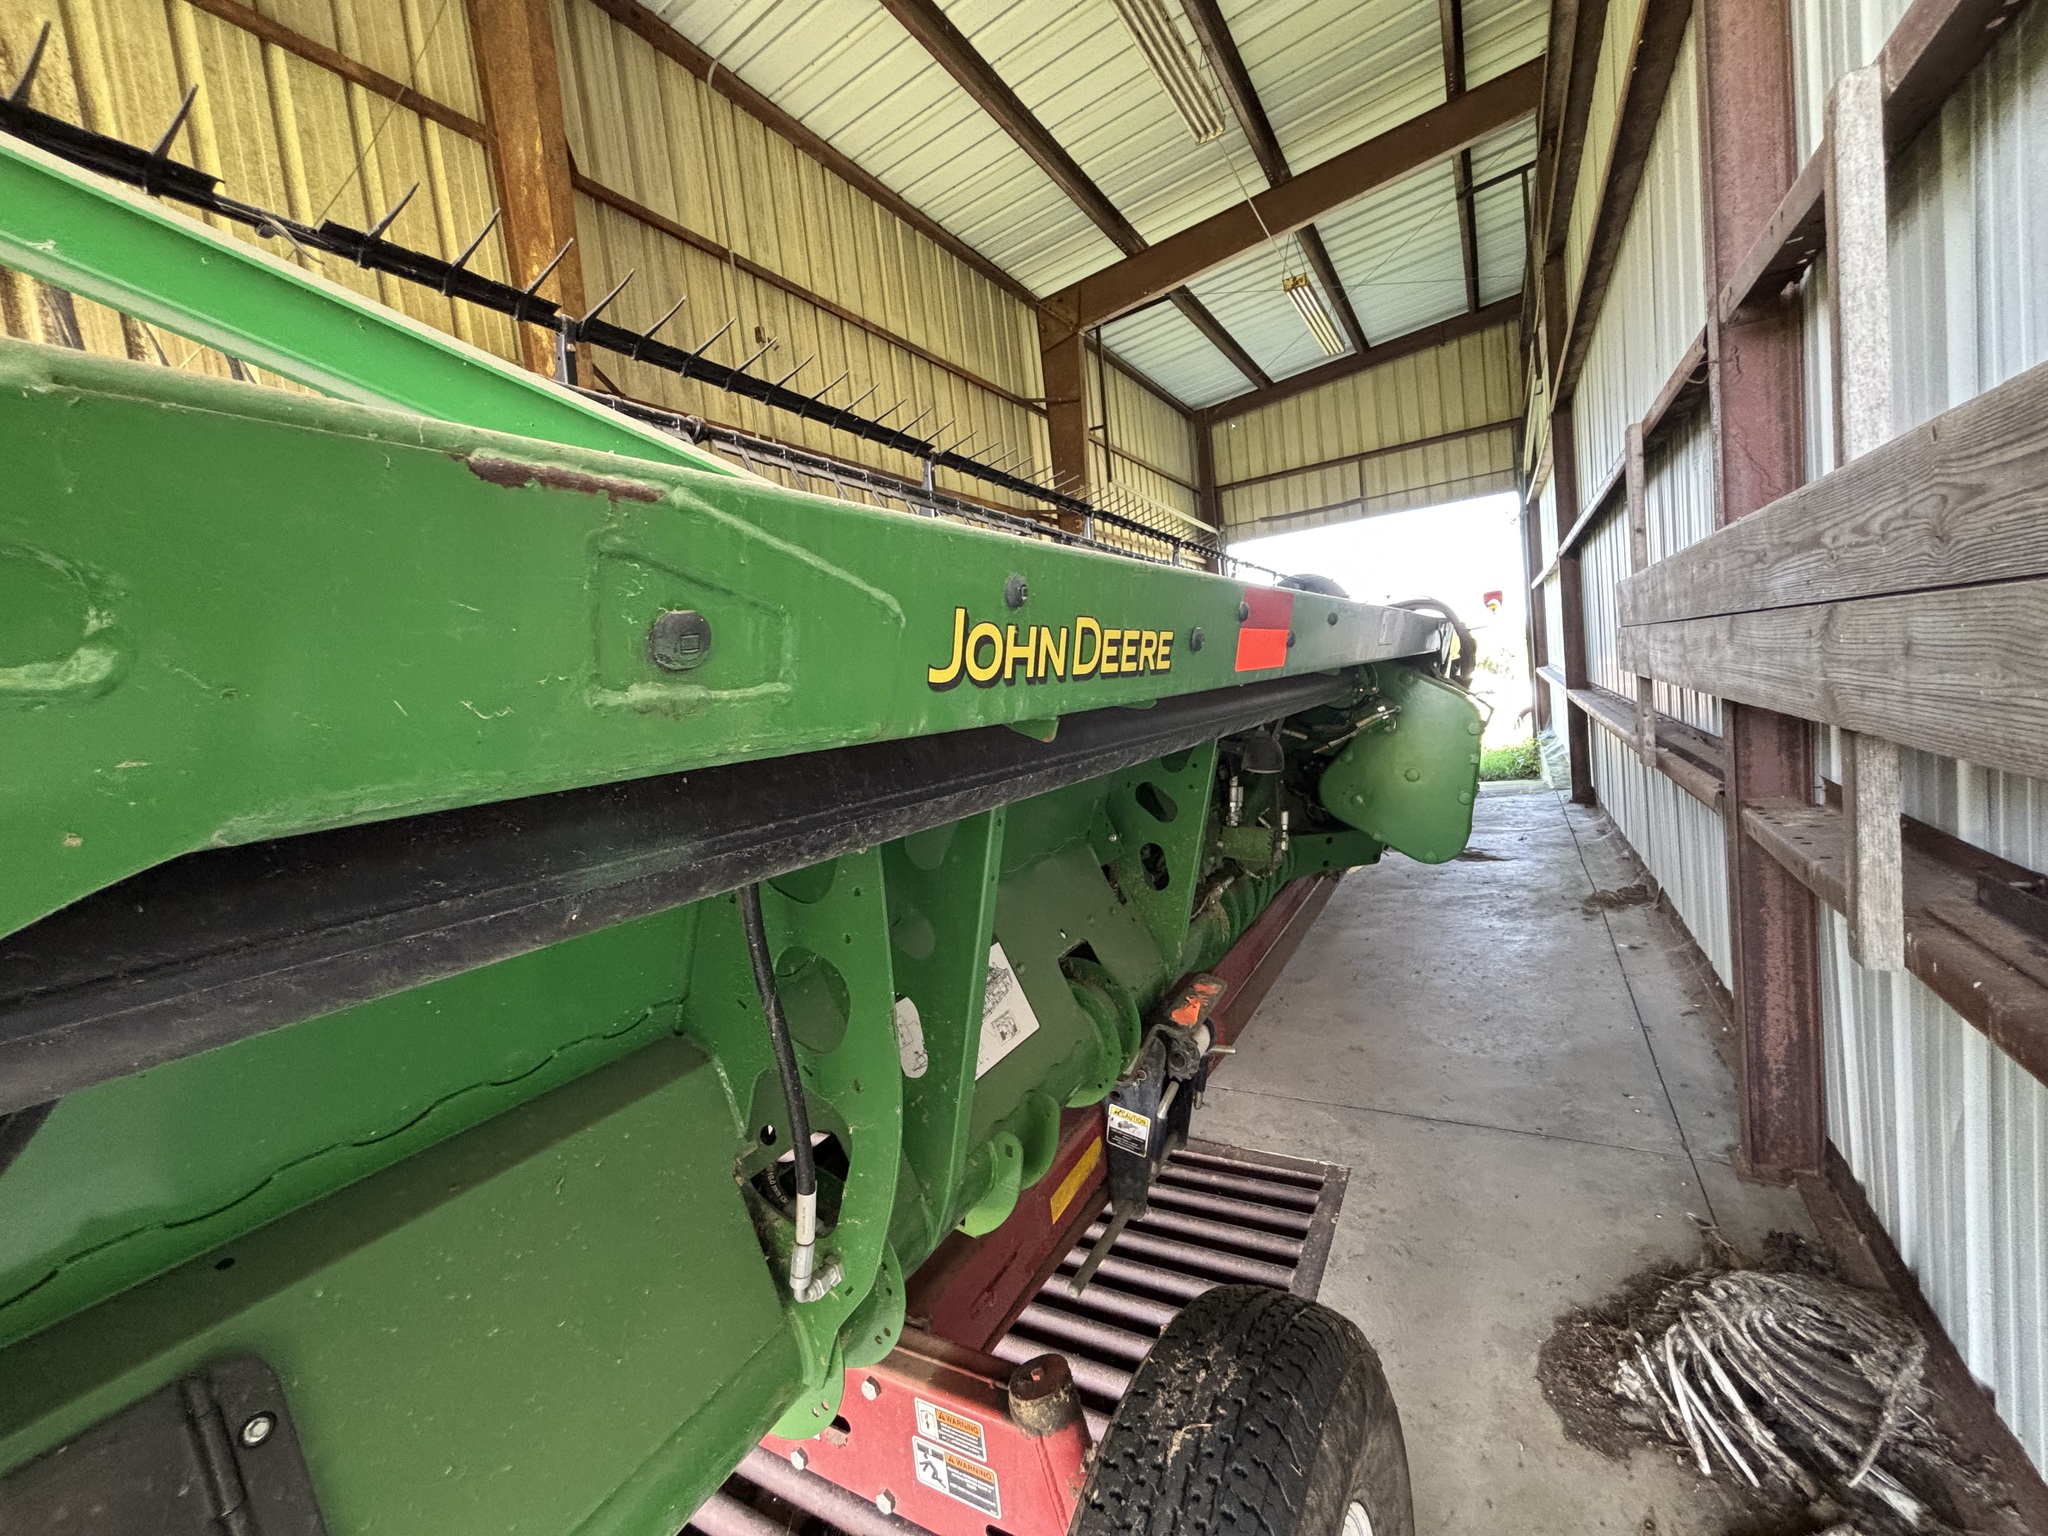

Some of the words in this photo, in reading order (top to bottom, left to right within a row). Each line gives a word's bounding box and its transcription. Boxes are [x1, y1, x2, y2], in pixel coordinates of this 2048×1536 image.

[927, 606, 1069, 692] JOHN
[1072, 615, 1175, 682] DEERE
[1121, 1111, 1146, 1125] CAUTION
[946, 1415, 979, 1434] WARNING
[956, 1459, 992, 1481] WARNING
